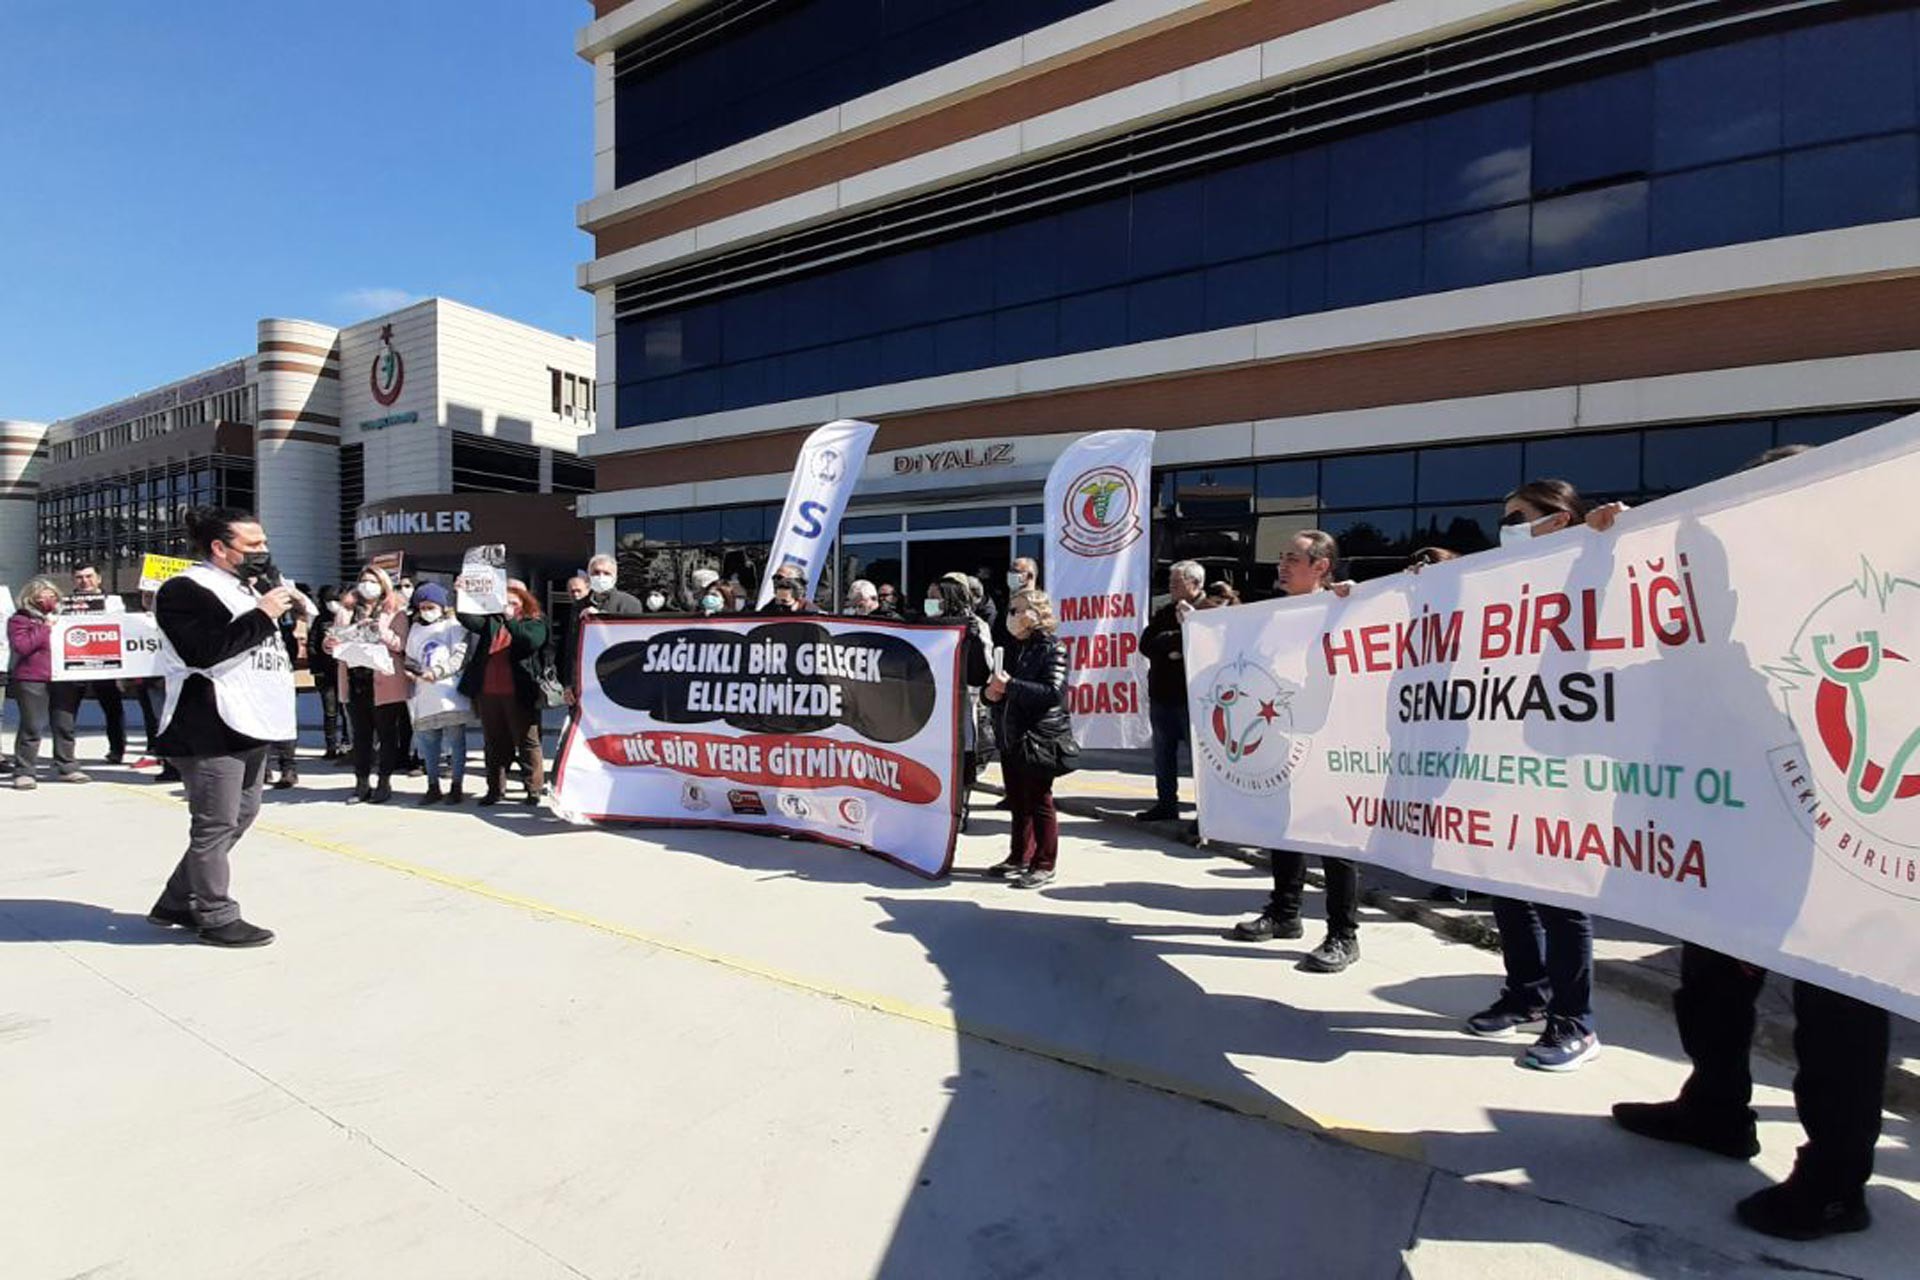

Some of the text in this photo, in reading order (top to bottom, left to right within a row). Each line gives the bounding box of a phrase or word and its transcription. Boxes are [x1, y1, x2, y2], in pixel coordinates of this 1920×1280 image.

[1323, 553, 1706, 675] HEKİM BİRLİĞİ
[643, 638, 882, 682] SAĞLIKLI BİR GELECEK
[687, 678, 842, 717] ELLERİMİZDE
[1399, 667, 1614, 723] SENDİKASI
[622, 734, 902, 791] HİÇ BİR YERE GİTMİYORUZ
[1327, 746, 1393, 776] BİRLİK
[1584, 759, 1684, 799] UMUT
[1695, 767, 1745, 808] OL
[1782, 759, 1832, 830] HEKİM
[1346, 796, 1494, 848] YUNUSEMRE
[1535, 817, 1707, 888] MANİSA
